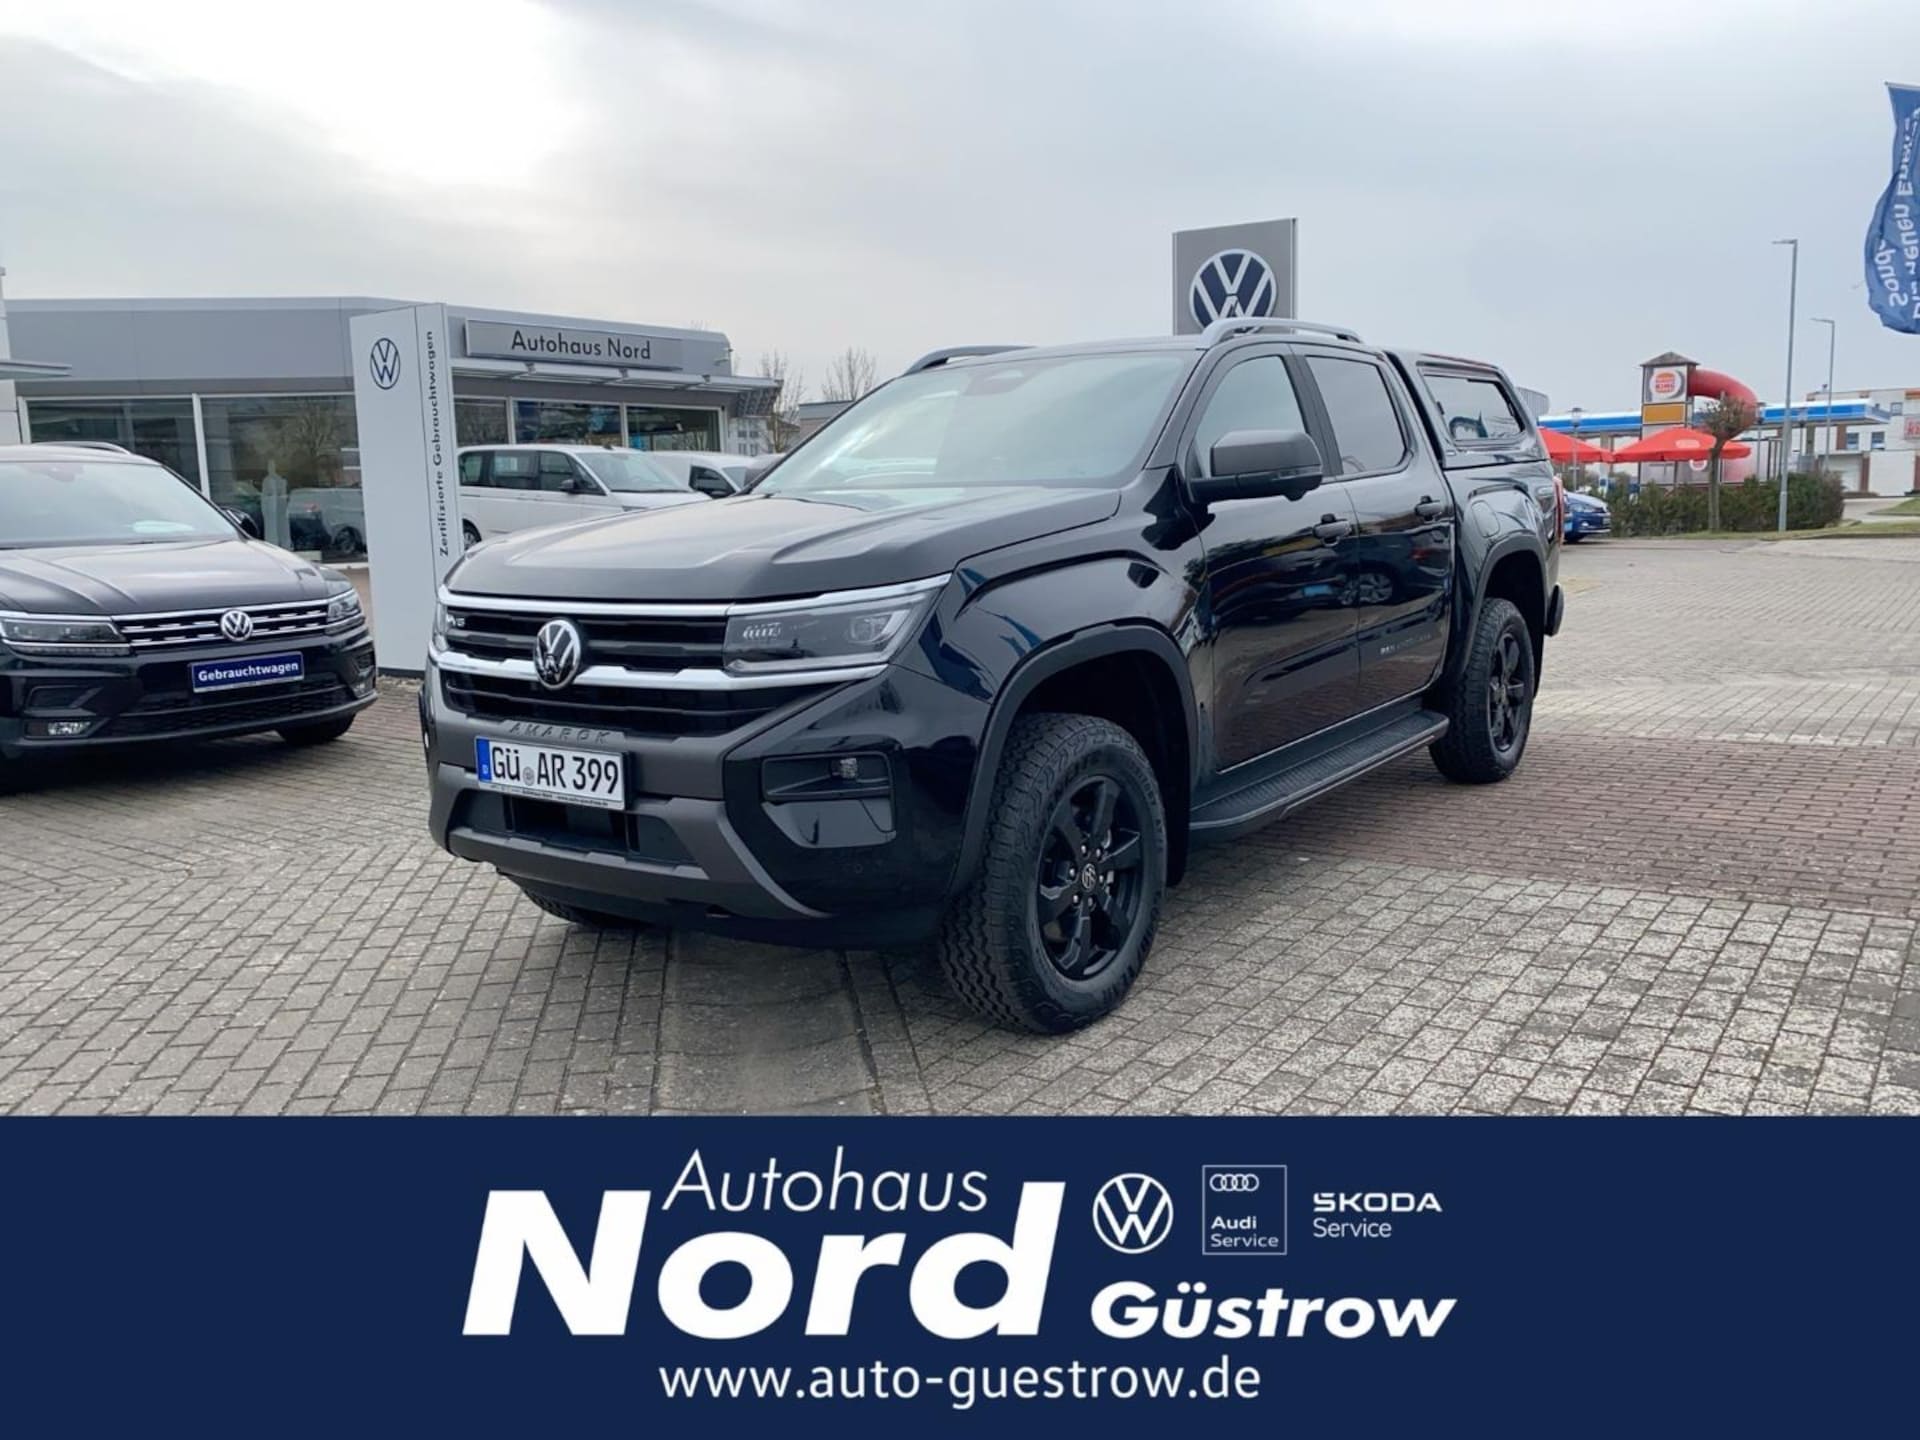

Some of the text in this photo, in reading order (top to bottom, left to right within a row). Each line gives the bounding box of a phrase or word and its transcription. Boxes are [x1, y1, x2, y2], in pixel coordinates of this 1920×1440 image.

[511, 329, 651, 360] Autohaus Nord
[426, 331, 449, 557] Zertifizierte Gebrauchtwagen
[198, 662, 299, 682] Gebrauchtwagen
[509, 723, 611, 744] AMAROK
[492, 746, 619, 795] GÜ AR 399
